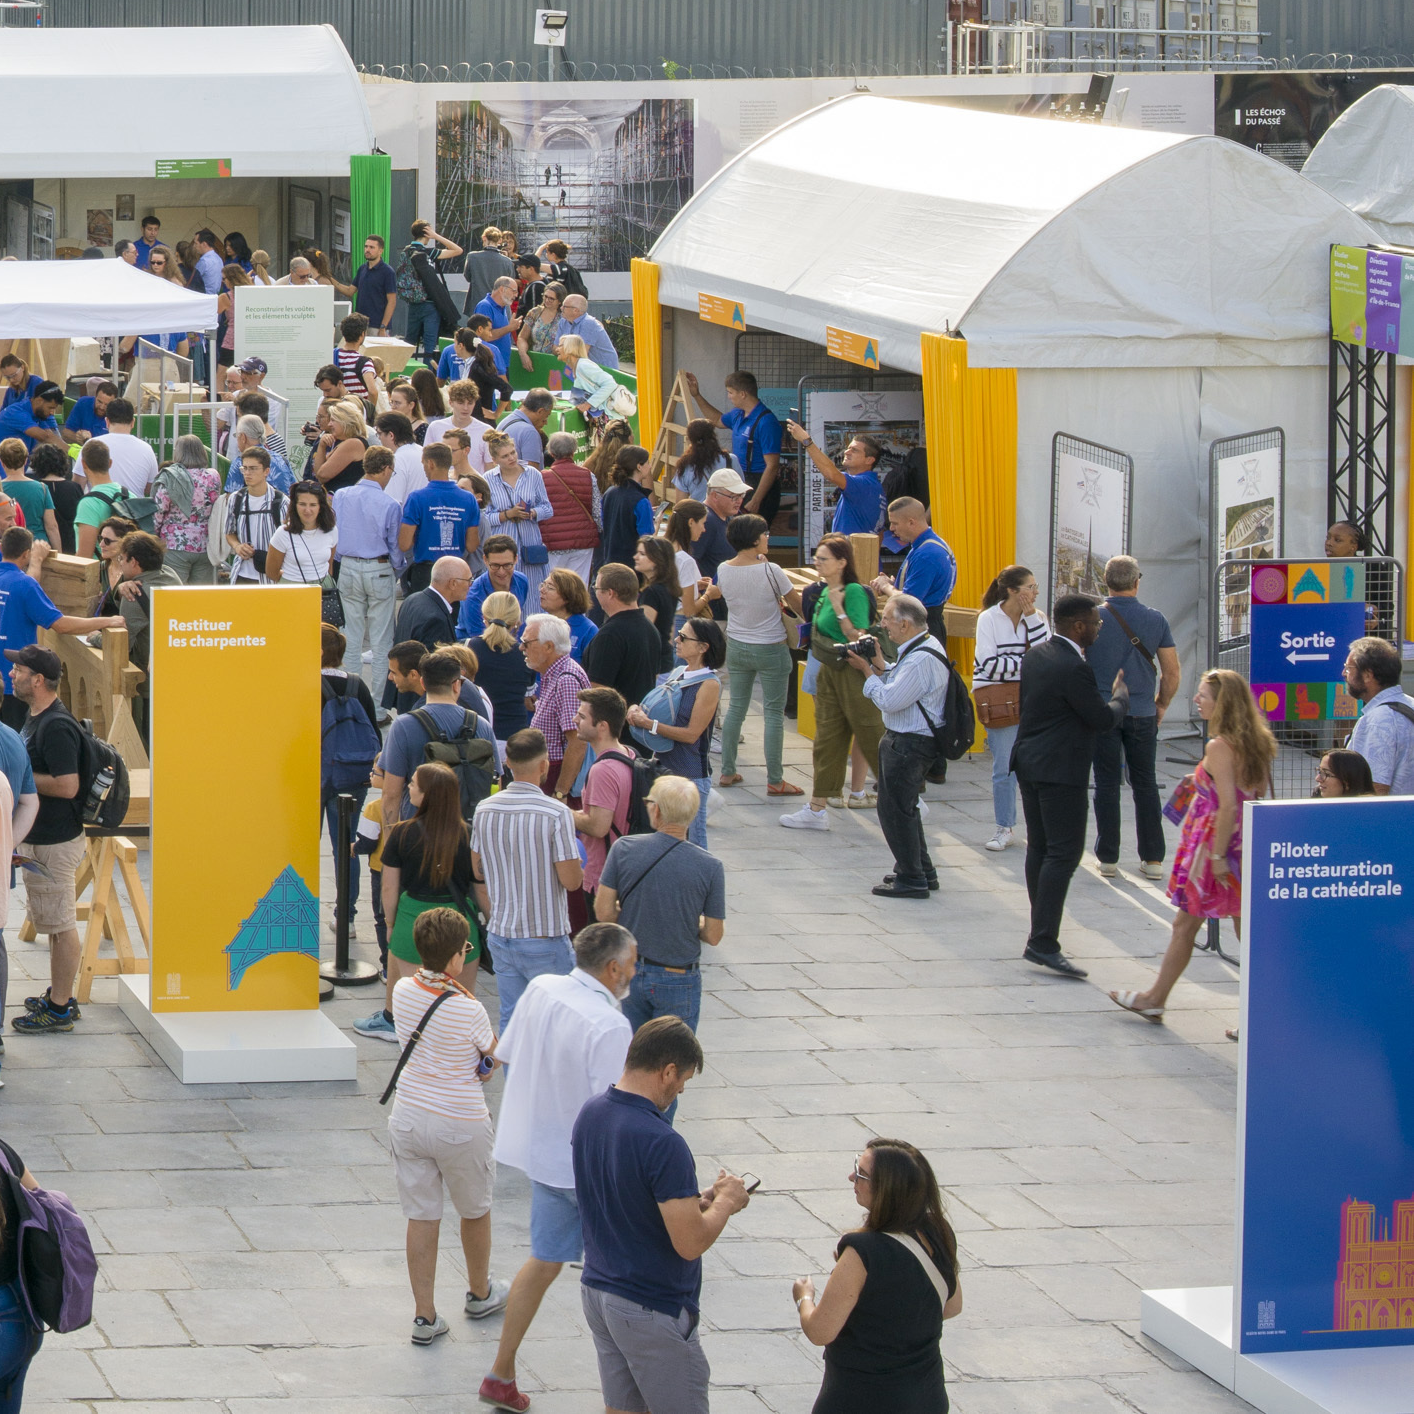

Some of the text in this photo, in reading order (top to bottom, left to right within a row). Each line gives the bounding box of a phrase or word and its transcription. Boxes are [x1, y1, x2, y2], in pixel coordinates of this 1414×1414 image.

[1260, 108, 1286, 116] ÉCHOS
[1258, 116, 1280, 125] PASSÉ
[1370, 257, 1388, 266] Direction
[1369, 268, 1388, 277] régionale
[1377, 278, 1392, 287] Affaires
[1370, 288, 1388, 296] culturelles
[169, 618, 232, 631] Restituer
[168, 634, 266, 650] les charpentes
[1280, 631, 1335, 648] Sortie
[1270, 842, 1328, 858] Piloter
[1269, 860, 1393, 879] la restauration
[1269, 880, 1402, 899] de la cathédrale
